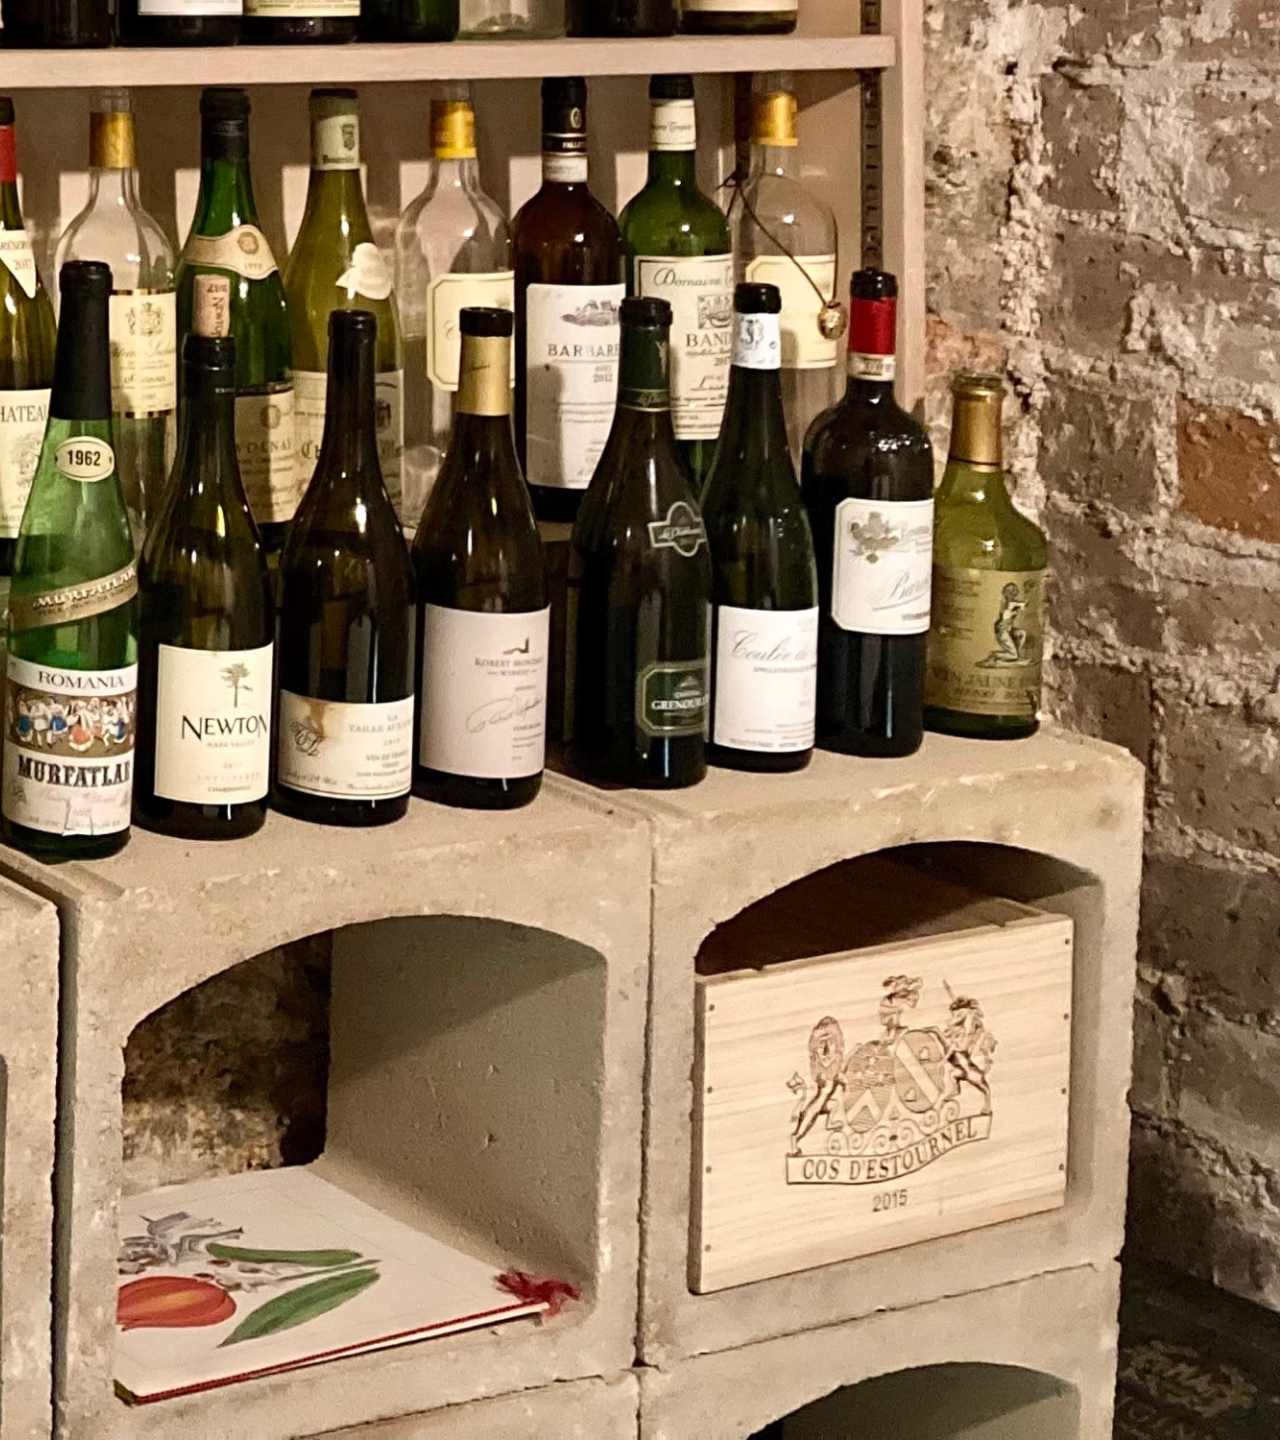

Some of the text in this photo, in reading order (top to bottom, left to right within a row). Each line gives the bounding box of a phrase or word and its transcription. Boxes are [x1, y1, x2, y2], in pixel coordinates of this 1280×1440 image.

[652, 266, 722, 290] Domaine
[67, 450, 102, 468] 1962
[38, 669, 125, 690] ROMANIA
[180, 713, 268, 742] NEWTON
[802, 1118, 978, 1182] COS D'ESTOURNEL
[871, 1188, 909, 1213] 2015
